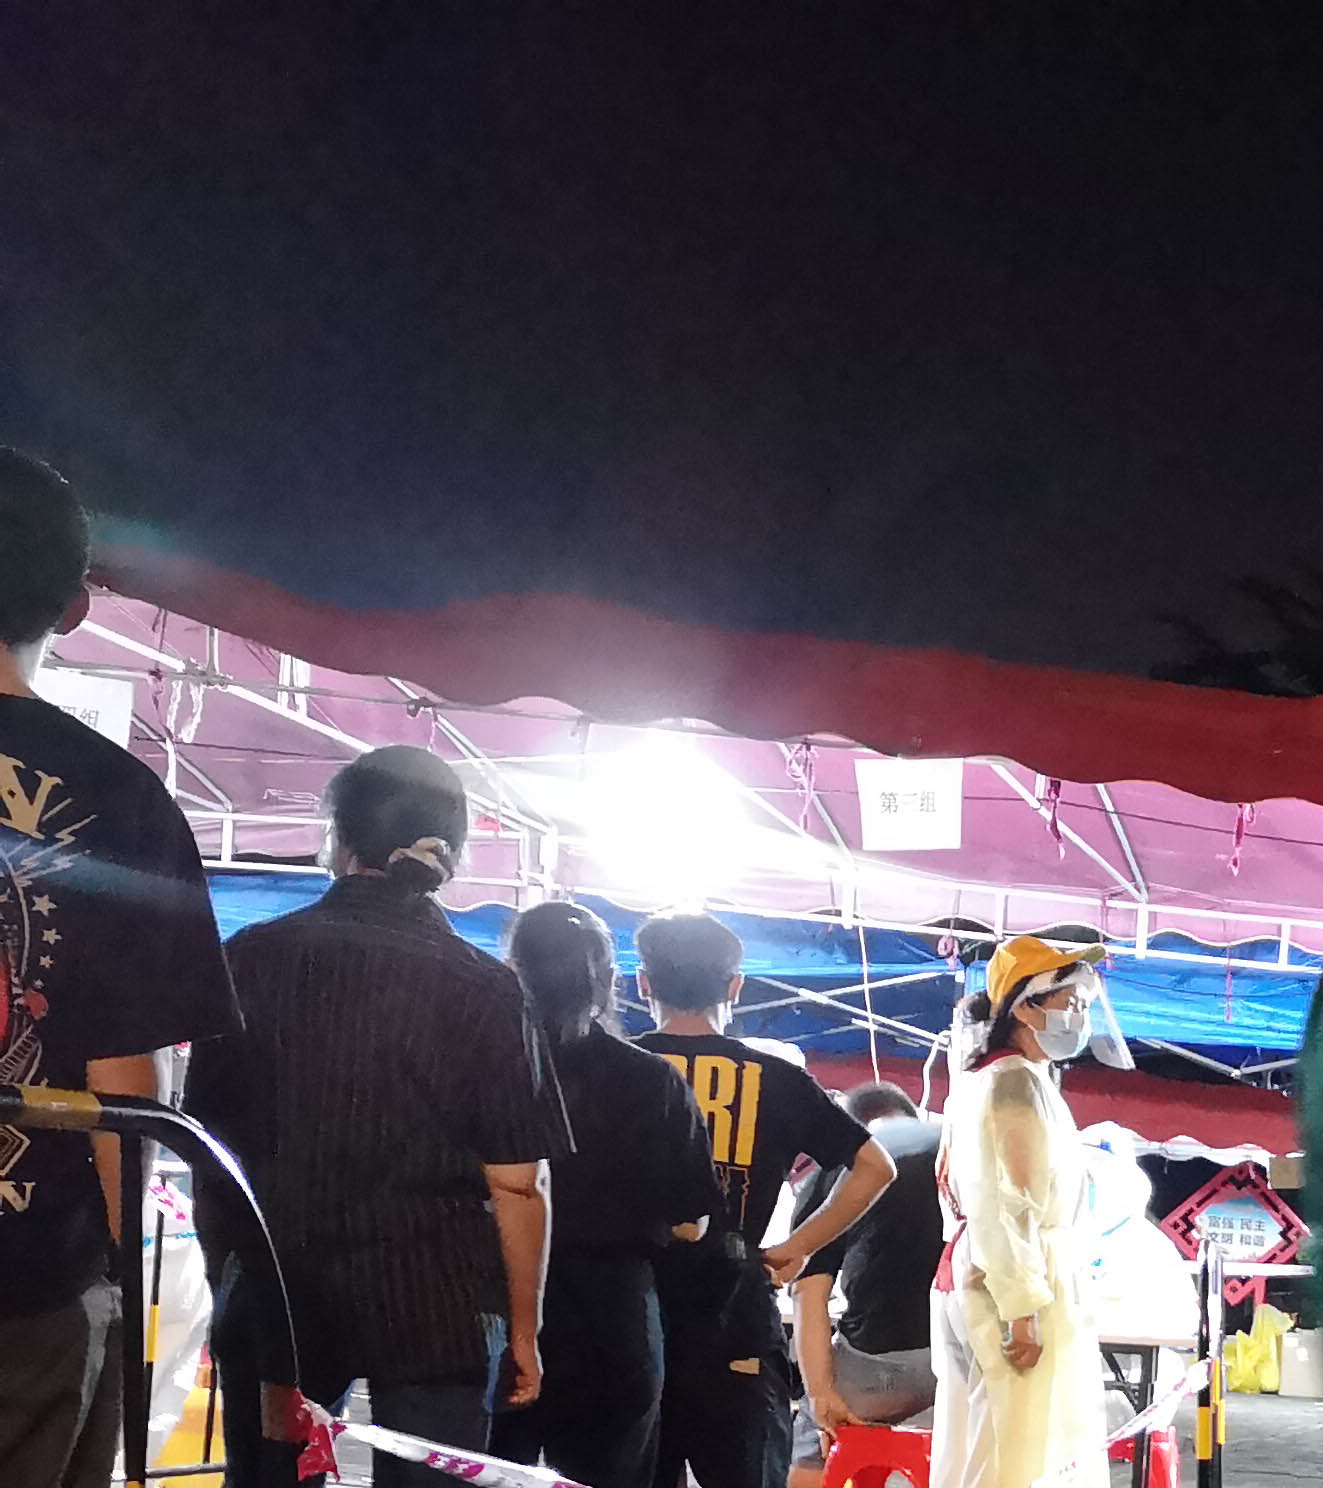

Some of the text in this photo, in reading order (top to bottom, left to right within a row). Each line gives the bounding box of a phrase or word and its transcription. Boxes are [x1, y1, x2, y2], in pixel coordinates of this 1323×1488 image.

[1208, 1215, 1266, 1232] 富强 民主
[1209, 1231, 1265, 1247] 文明 和谐
